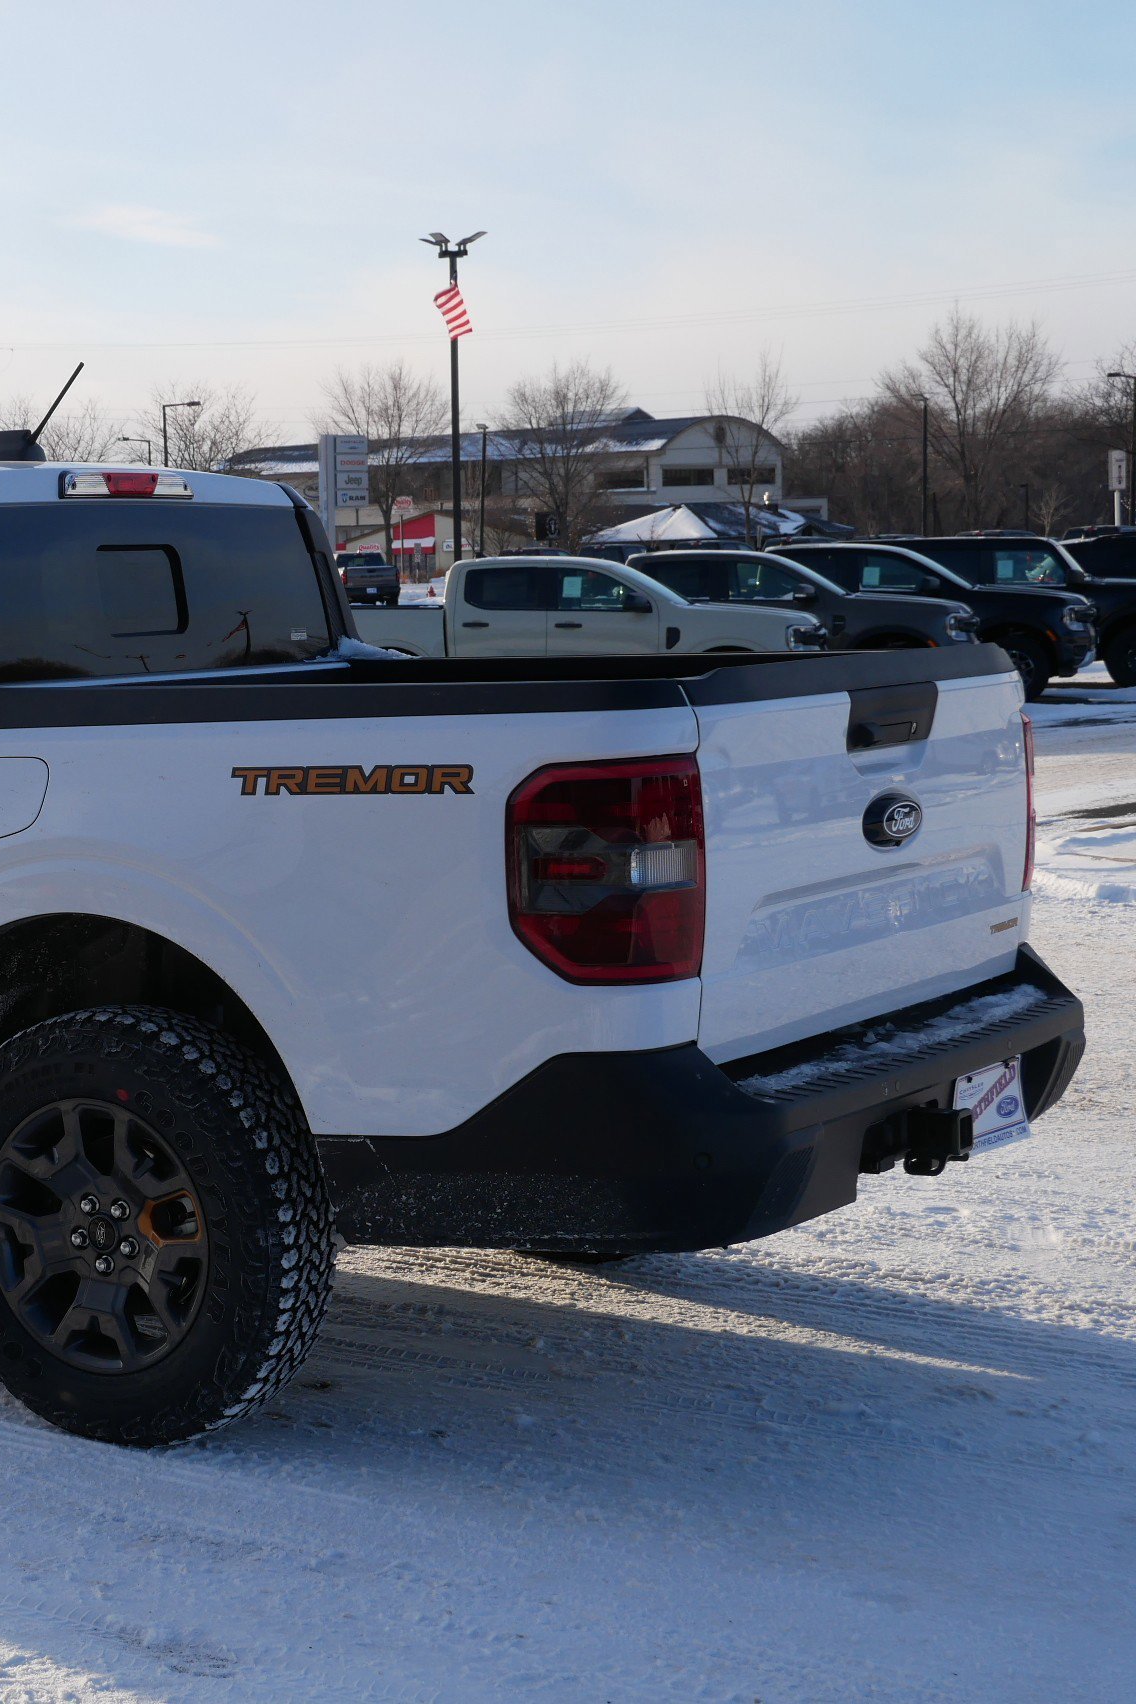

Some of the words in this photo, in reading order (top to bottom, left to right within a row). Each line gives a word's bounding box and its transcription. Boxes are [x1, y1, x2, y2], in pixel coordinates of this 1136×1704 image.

[345, 474, 363, 487] Jeep
[230, 764, 475, 796] TREMOR
[892, 807, 915, 832] Ford
